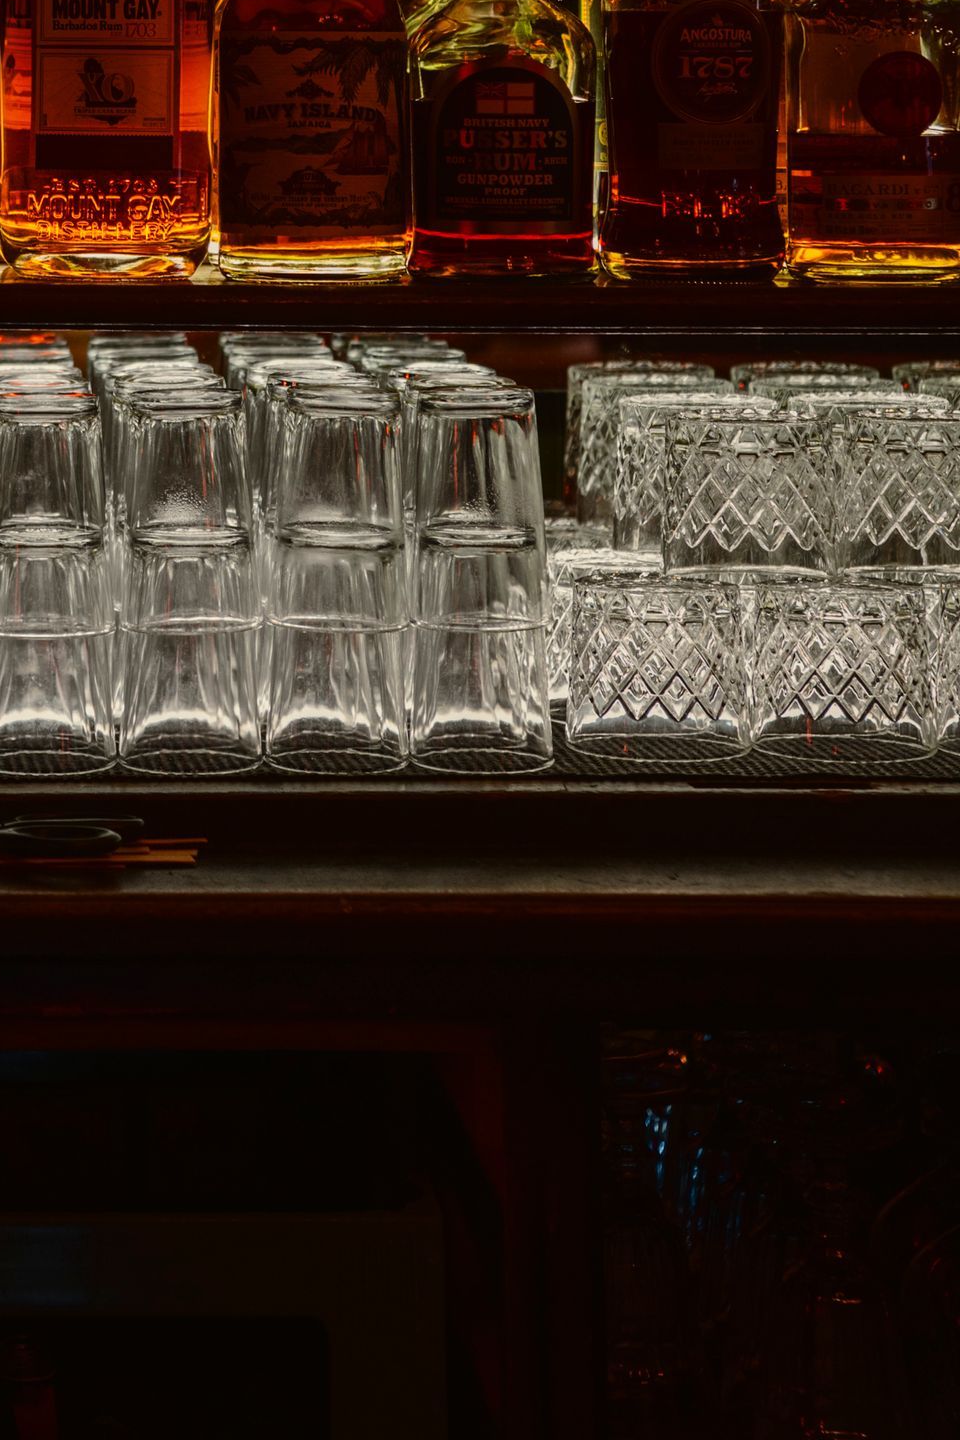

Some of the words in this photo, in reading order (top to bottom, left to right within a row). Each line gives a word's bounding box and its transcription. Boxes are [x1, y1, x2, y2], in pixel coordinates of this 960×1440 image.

[52, 20, 98, 31] Barbados
[99, 20, 123, 31] Rum
[125, 22, 157, 38] 1703
[680, 27, 753, 42] ANGOSTURA
[676, 55, 753, 79] 1787
[300, 102, 377, 122] ISLAND
[464, 118, 514, 127] BRITISH
[515, 118, 550, 127] NAVY
[444, 128, 569, 149] PUSSER'S
[456, 173, 554, 186] GUNPOWDER
[484, 187, 528, 196] PROOF
[28, 193, 121, 221] MOUNT
[37, 220, 174, 241] DISTILLERY
